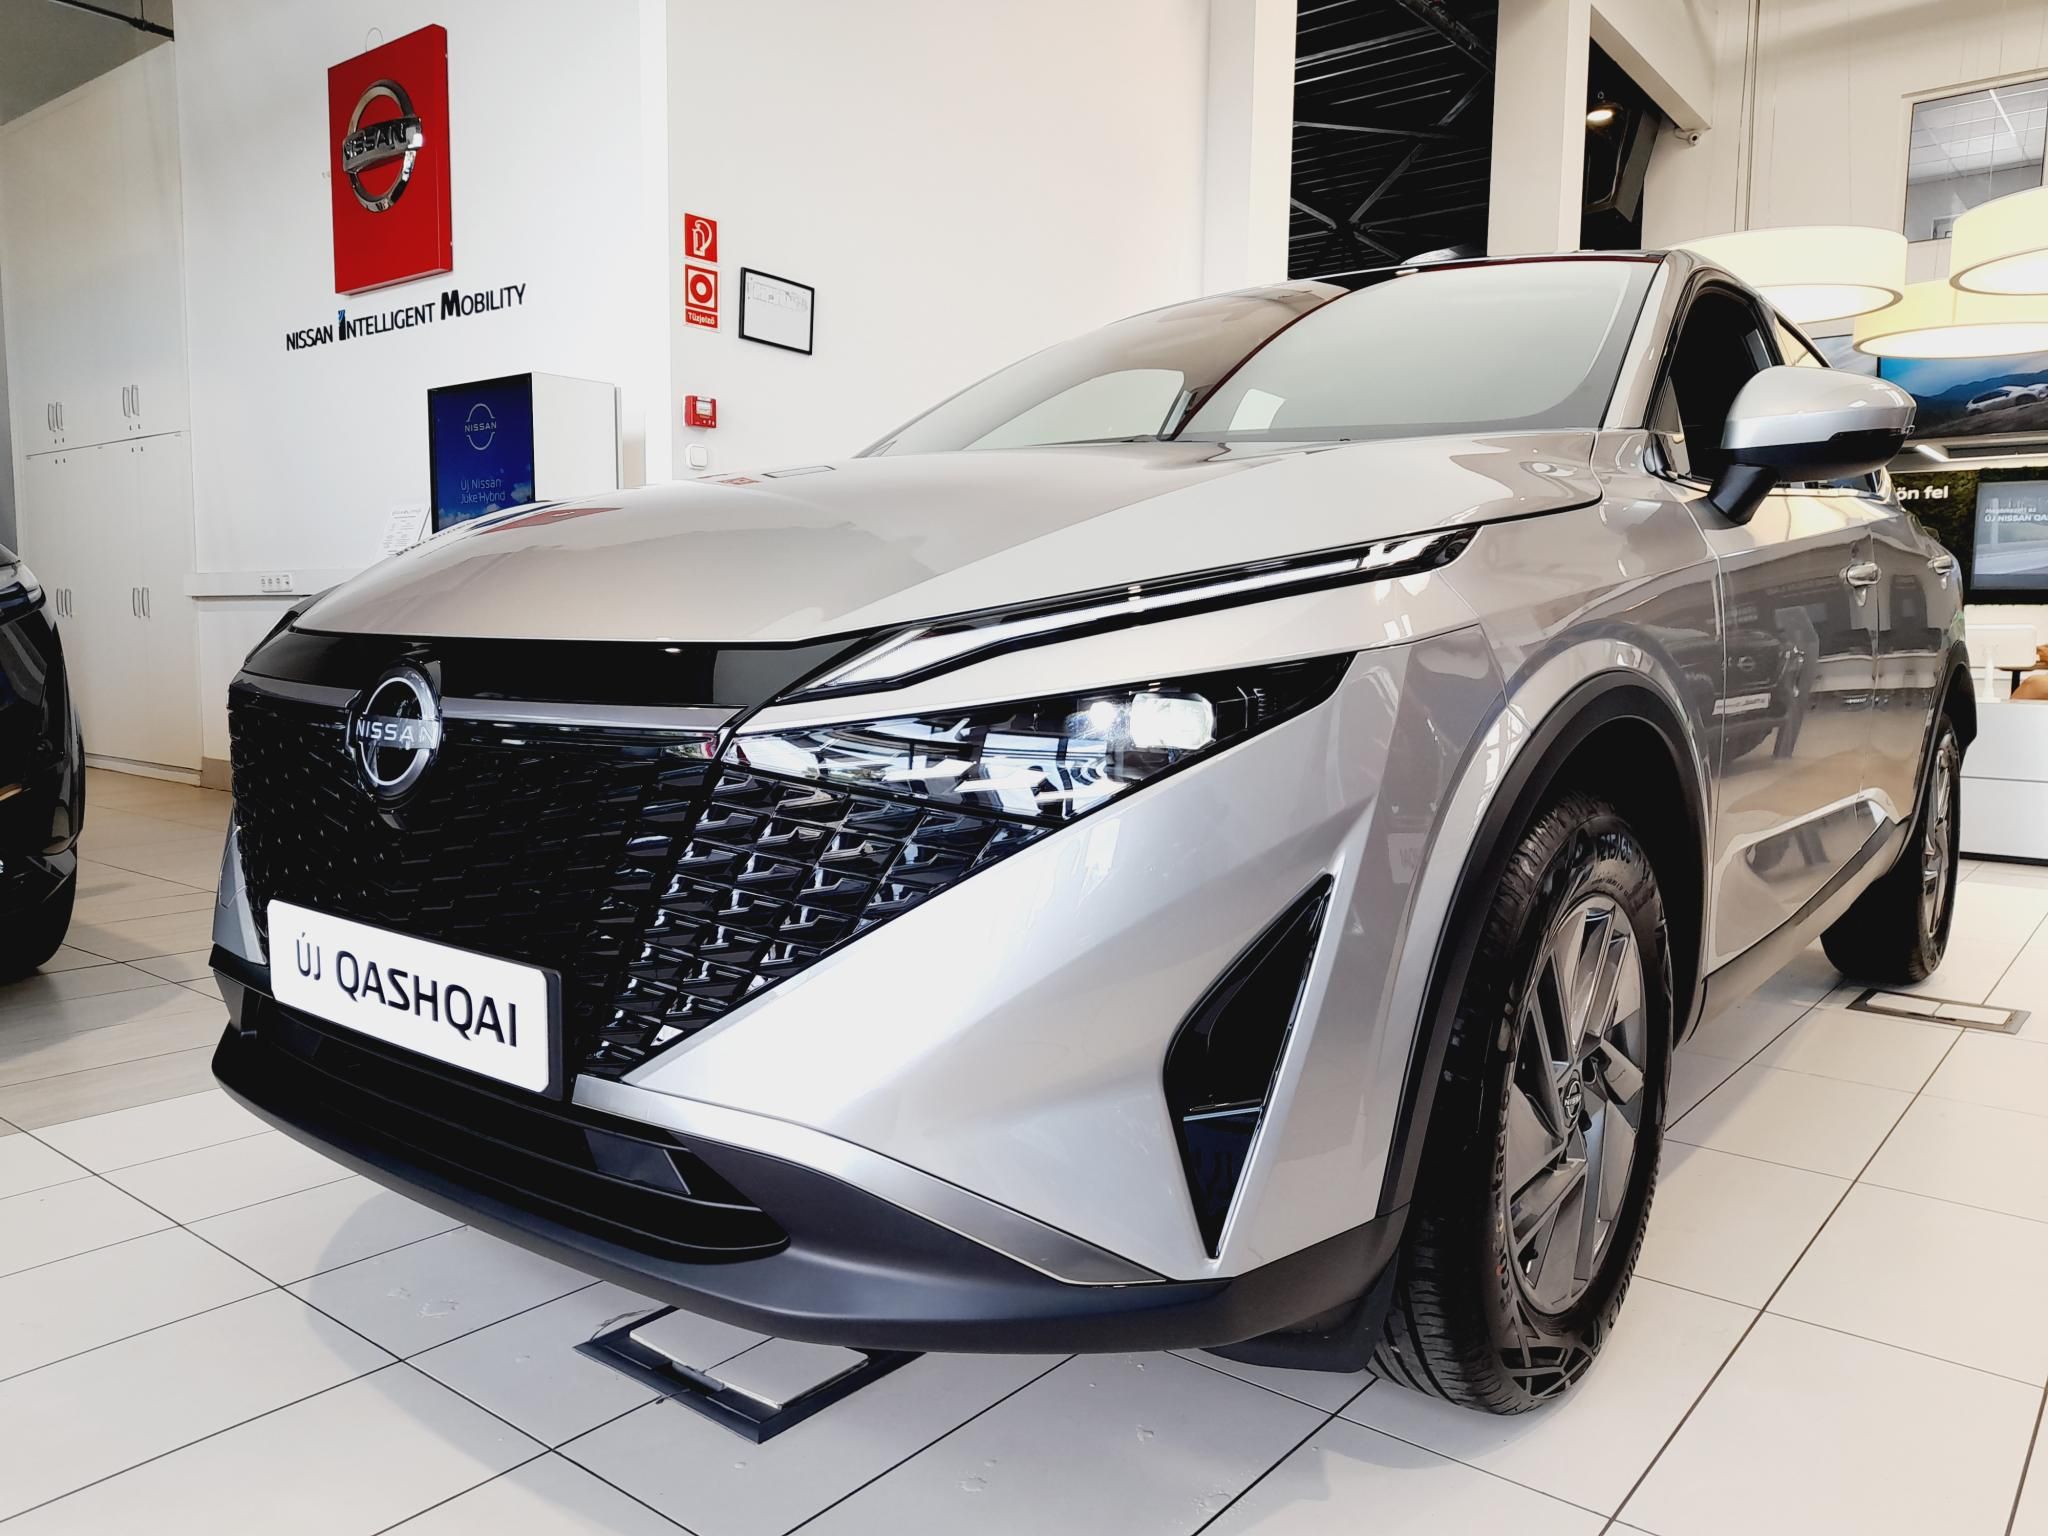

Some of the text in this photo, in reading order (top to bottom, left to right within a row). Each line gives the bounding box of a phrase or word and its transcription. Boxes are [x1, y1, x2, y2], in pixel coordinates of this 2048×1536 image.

[286, 283, 526, 351] NISSAN INTELLIGENT MOBILITY
[464, 421, 497, 432] NISSAN
[472, 478, 502, 490] Nissan
[460, 490, 506, 504] Juke Hybrid
[1923, 485, 1949, 500] fel
[1998, 514, 2032, 522] NISSAN
[356, 719, 440, 749] NISSAN
[296, 932, 518, 1049] ÚJ QASHQAI
